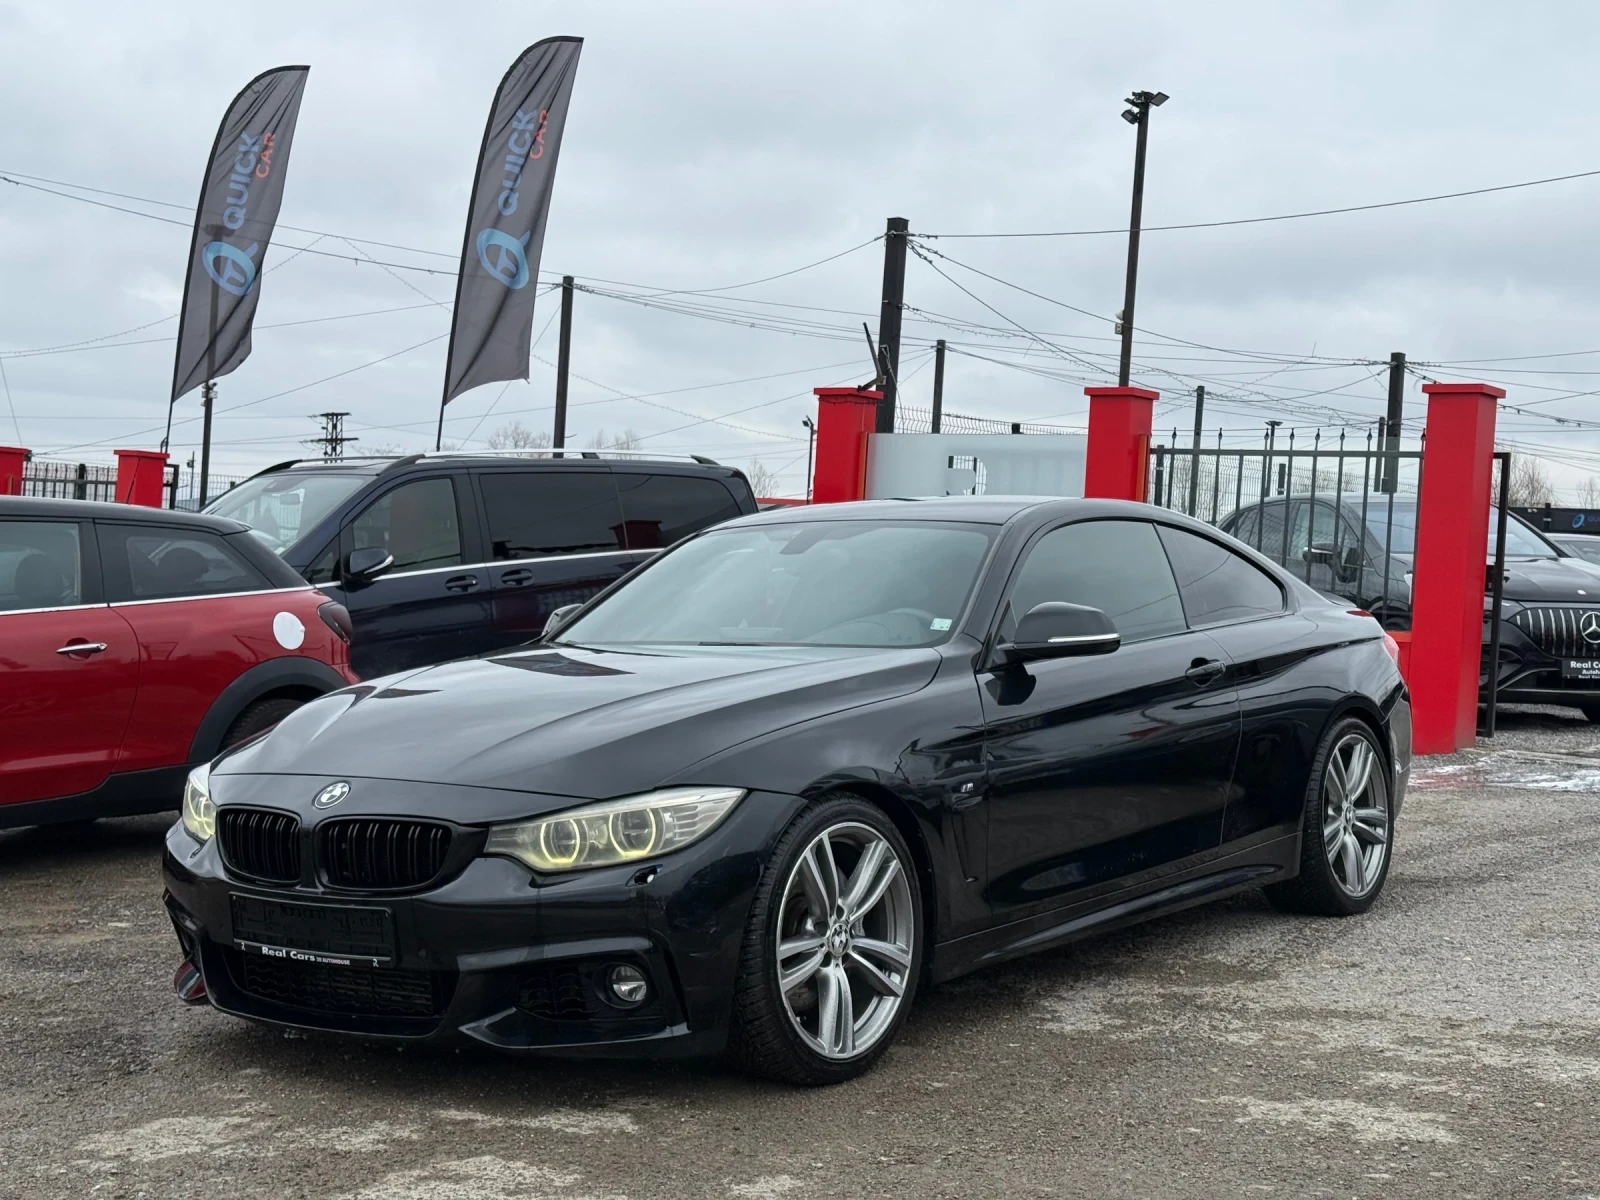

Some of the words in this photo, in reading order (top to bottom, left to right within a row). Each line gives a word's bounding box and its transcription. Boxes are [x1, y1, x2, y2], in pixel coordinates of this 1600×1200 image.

[255, 131, 276, 178] CAR
[498, 109, 537, 216] QUICK
[222, 130, 260, 230] QUICK
[1570, 660, 1591, 668] Real
[261, 946, 286, 958] Real
[290, 950, 316, 962] Cars
